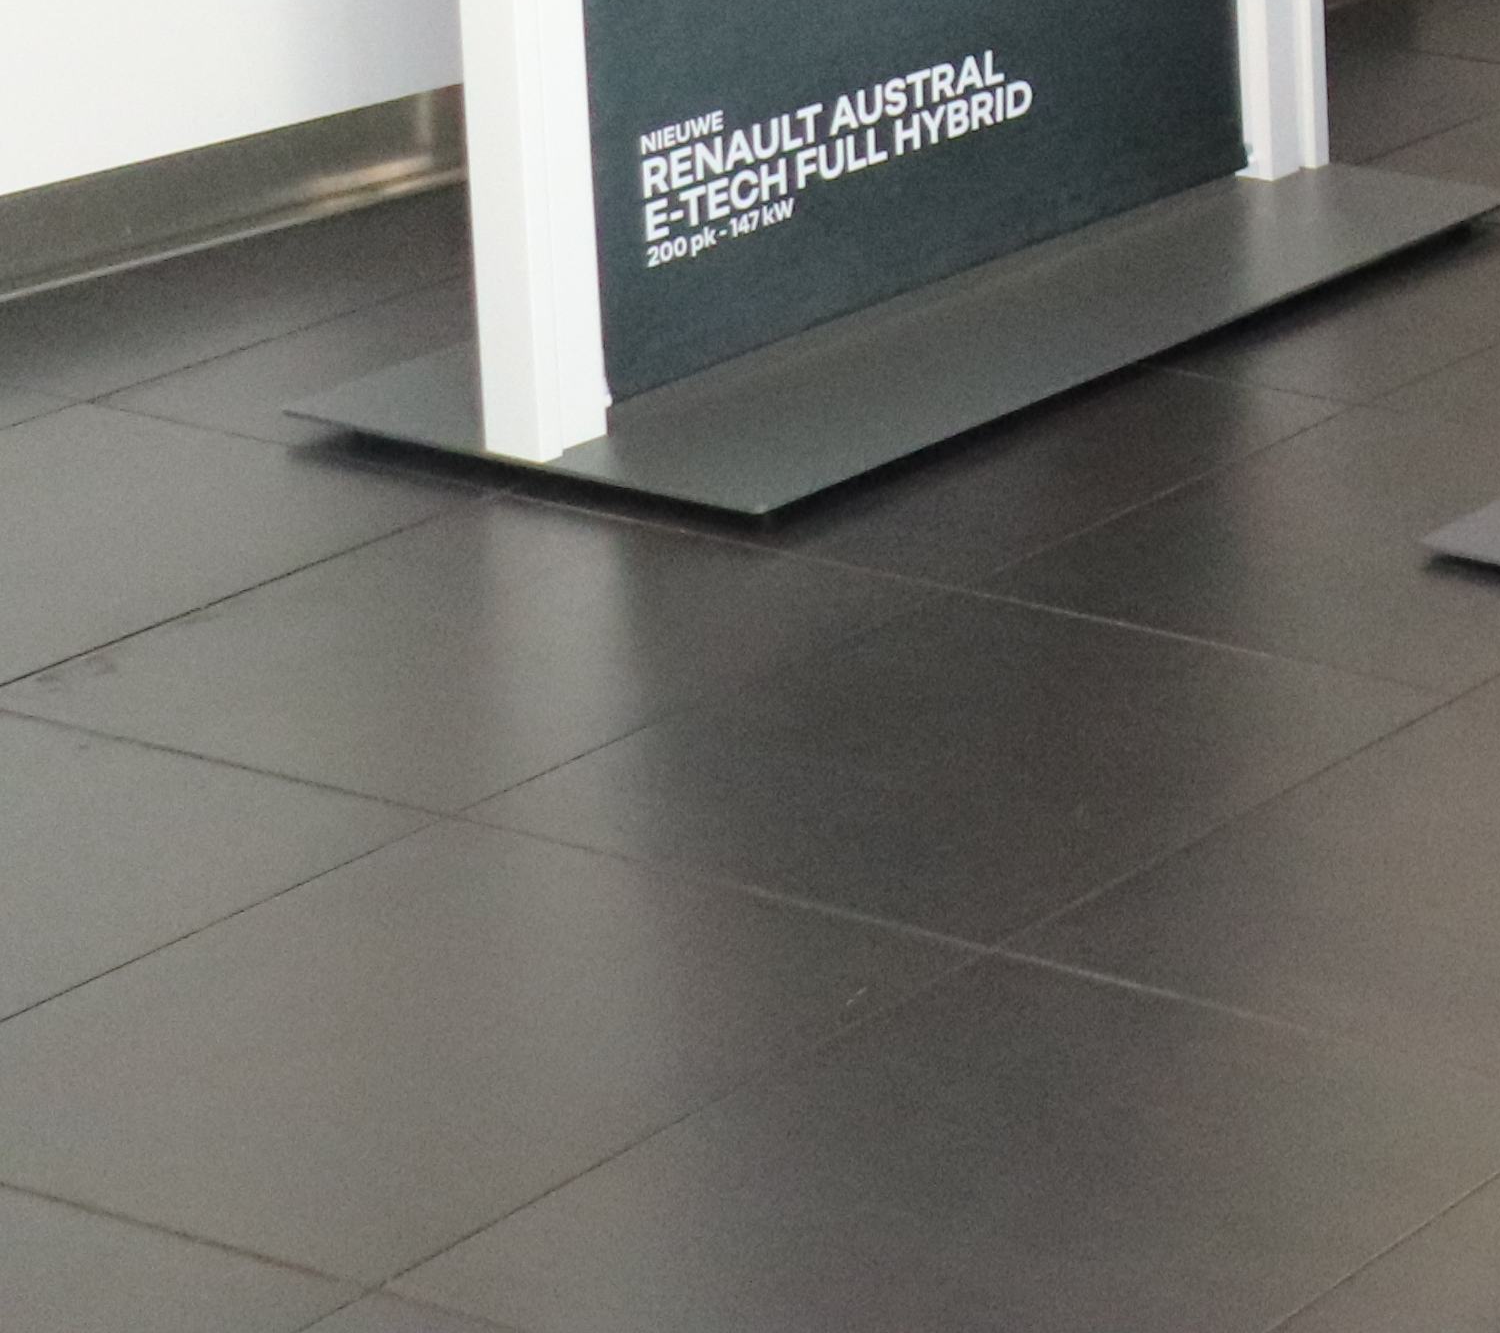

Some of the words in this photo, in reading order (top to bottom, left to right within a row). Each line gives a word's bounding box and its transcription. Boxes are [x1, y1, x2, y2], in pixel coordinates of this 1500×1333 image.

[640, 109, 724, 156] NIEUWE
[642, 102, 823, 199] RENAULT
[829, 49, 1006, 137] AUSTRAL
[645, 157, 788, 243] E-TECH
[795, 127, 888, 190] FULL
[894, 80, 1034, 156] HYBRID
[646, 236, 688, 268] 200
[690, 225, 717, 258] pk
[729, 208, 761, 238] 147
[762, 196, 795, 227] kW
